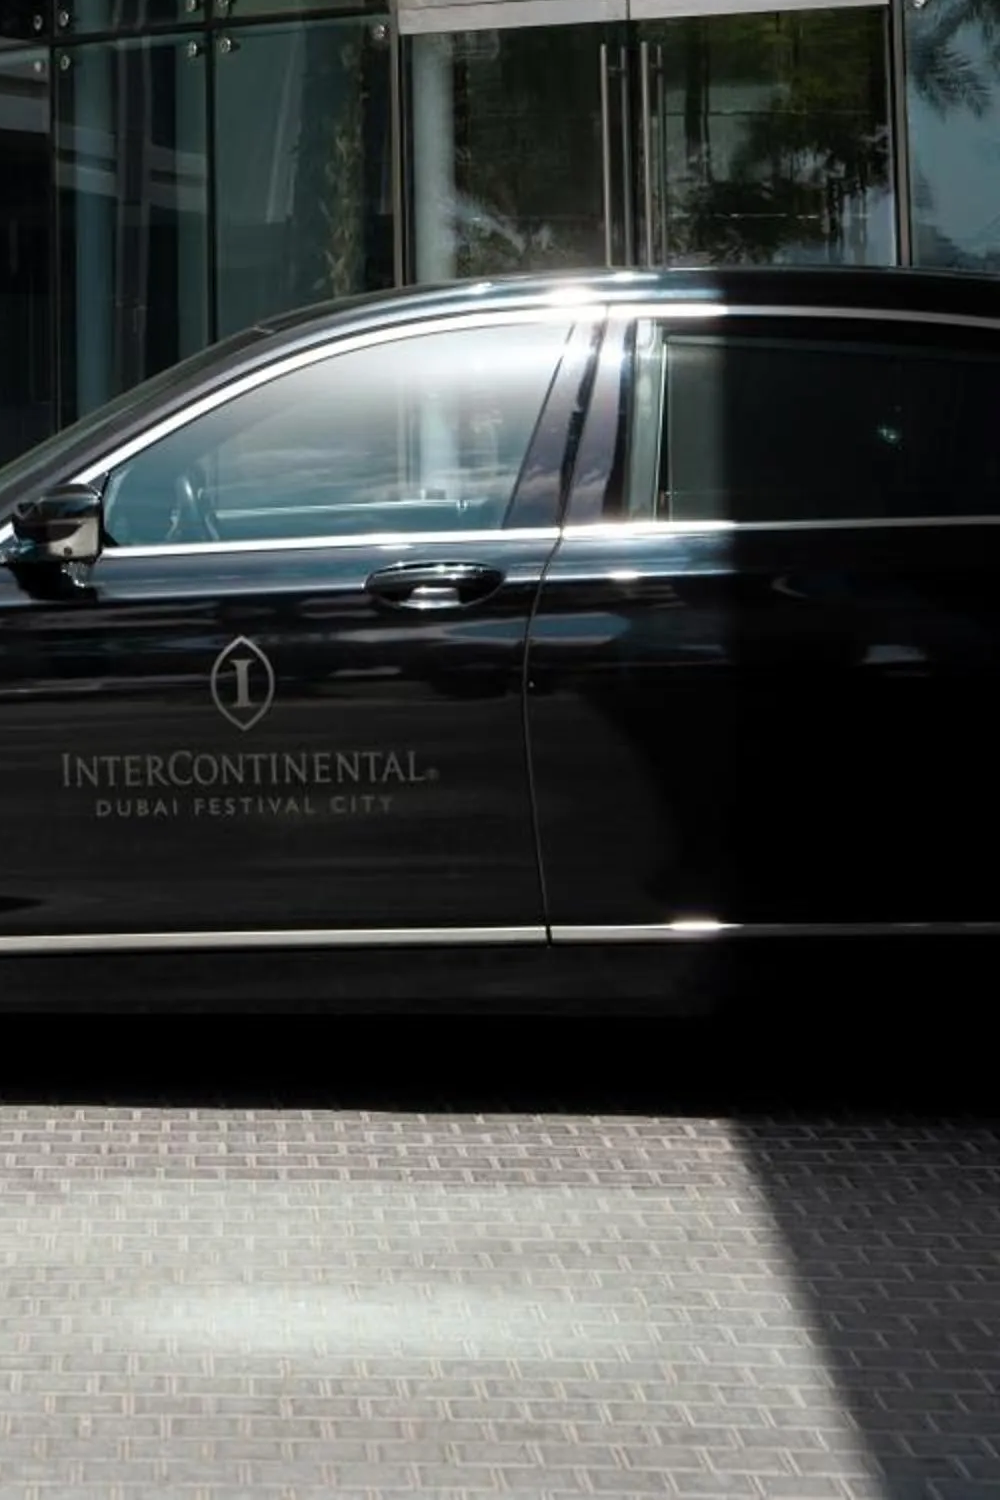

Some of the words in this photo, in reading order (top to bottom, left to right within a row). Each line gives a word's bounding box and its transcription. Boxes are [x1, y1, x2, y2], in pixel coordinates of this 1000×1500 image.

[61, 749, 427, 787] INTERCONTINENTAL
[96, 798, 179, 817] DUBAI
[194, 797, 316, 816] FESTIVAL
[330, 795, 394, 814] CITY
